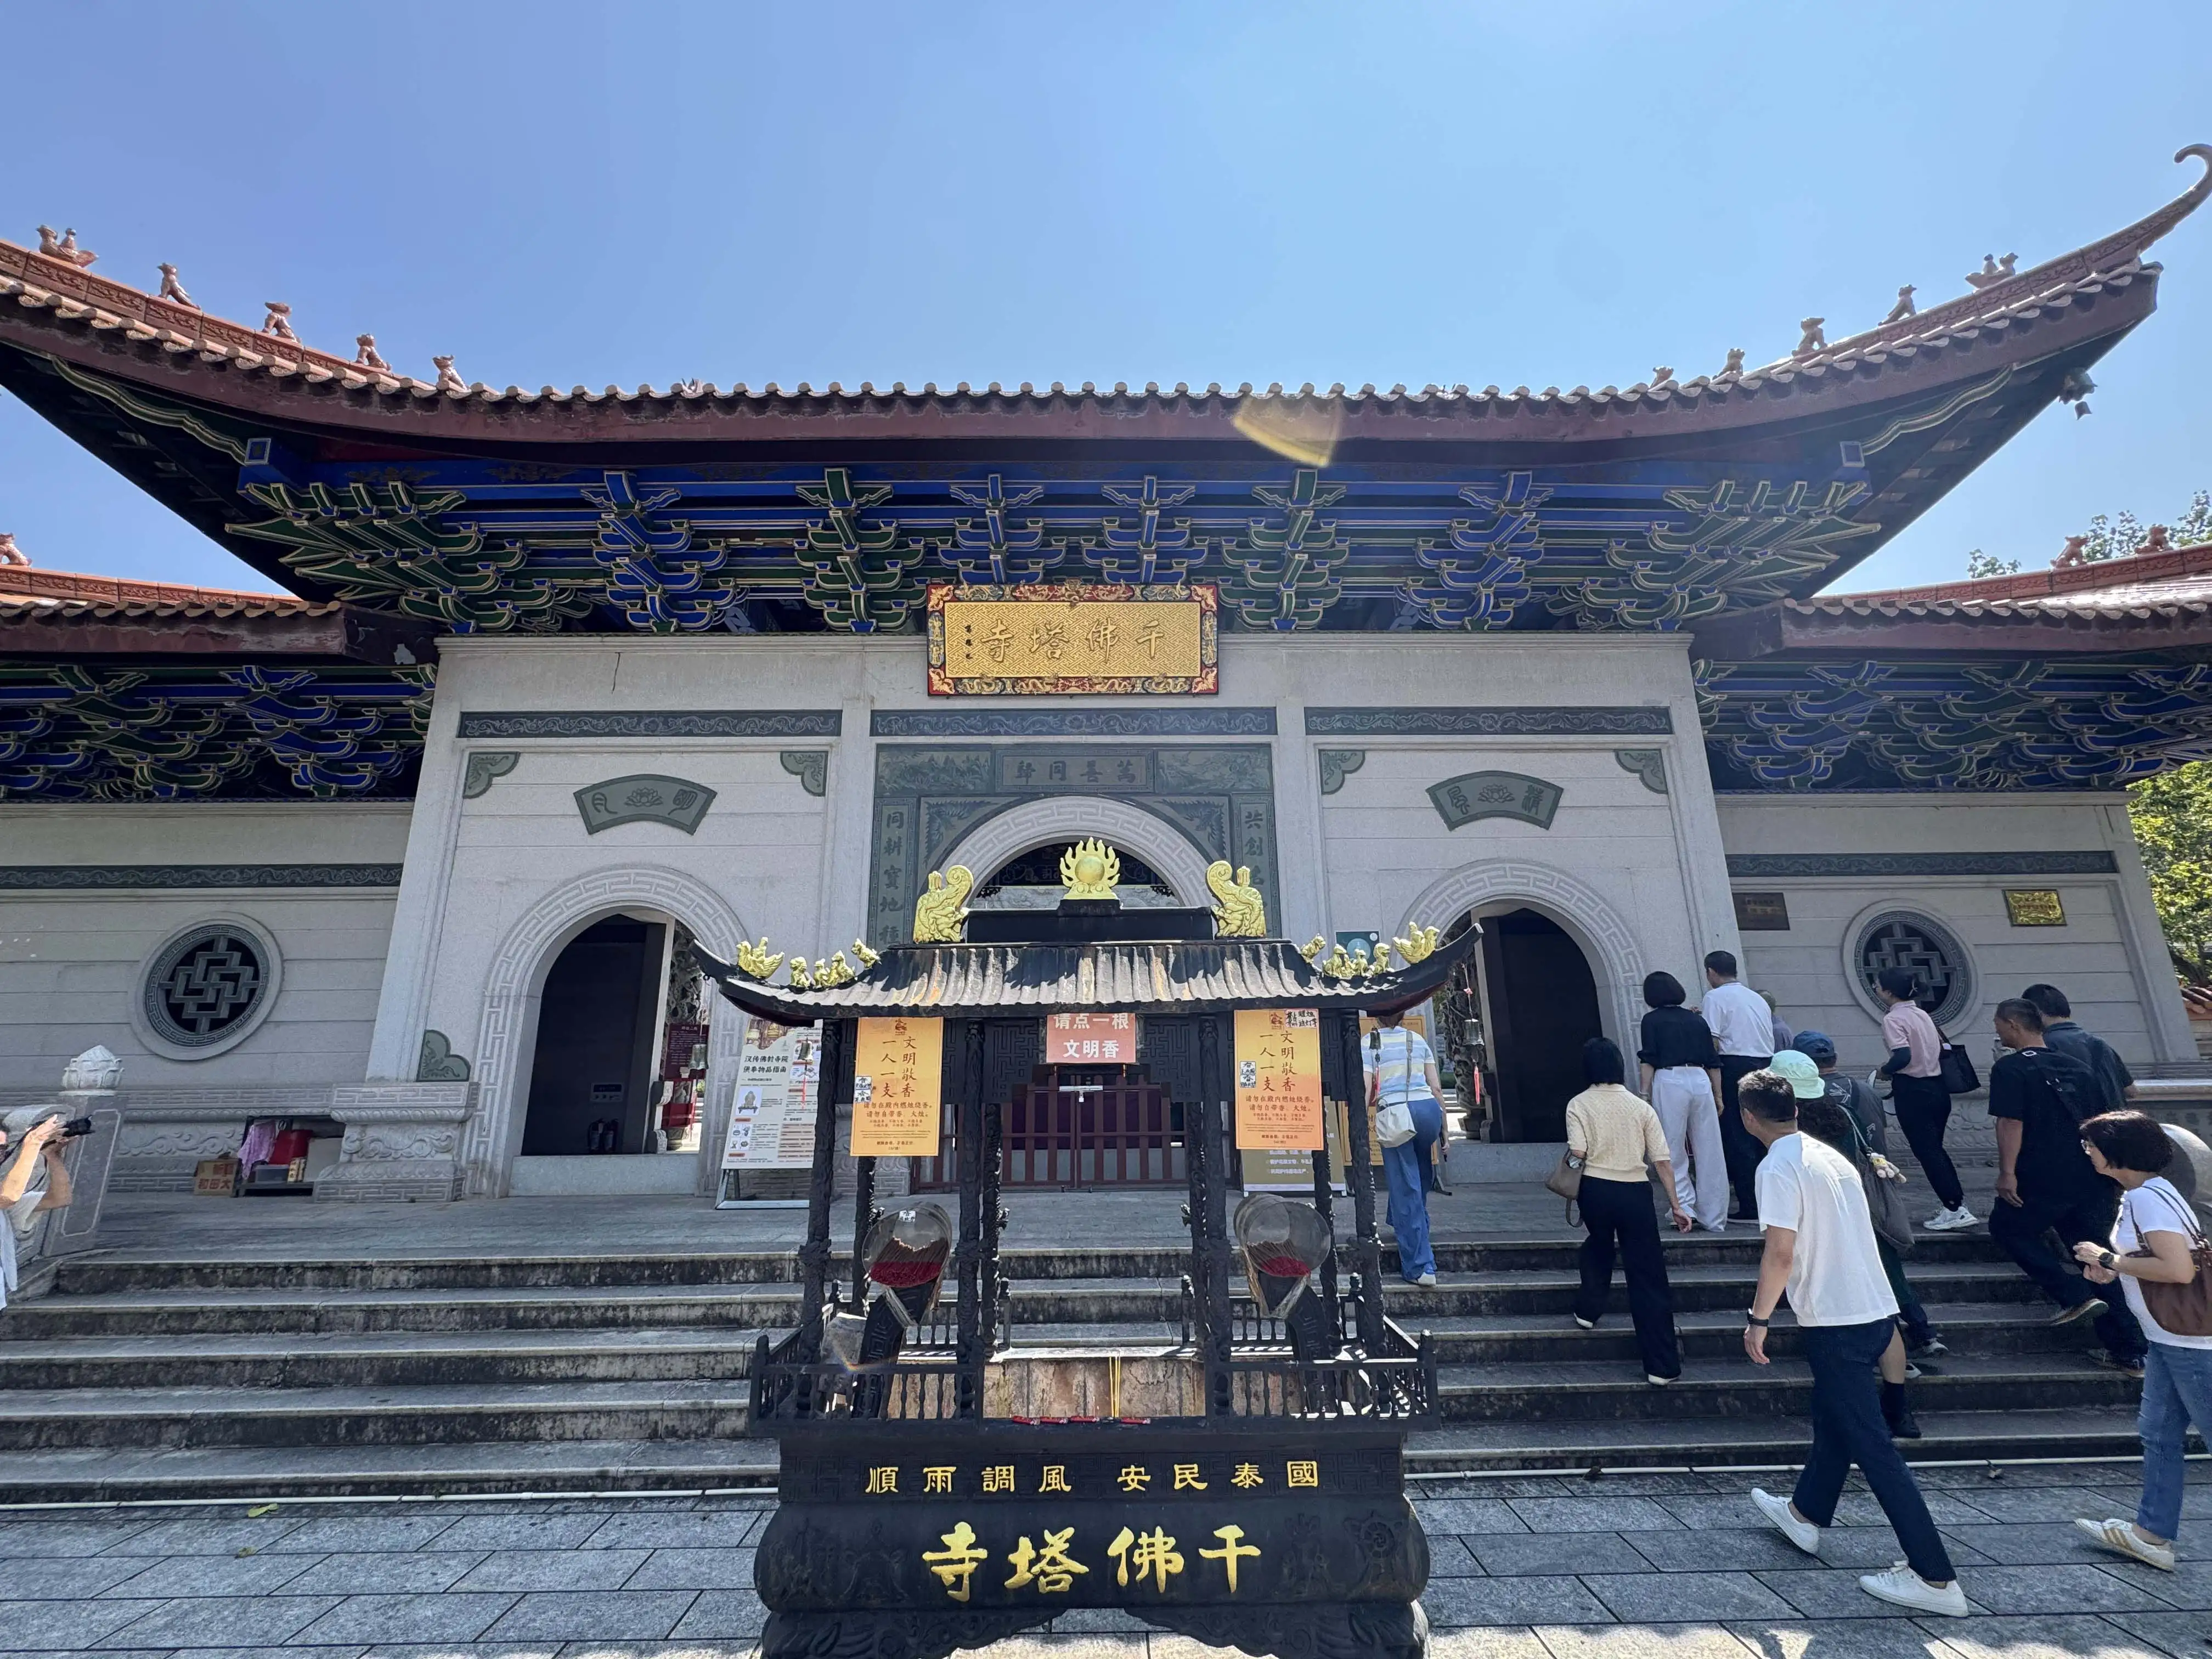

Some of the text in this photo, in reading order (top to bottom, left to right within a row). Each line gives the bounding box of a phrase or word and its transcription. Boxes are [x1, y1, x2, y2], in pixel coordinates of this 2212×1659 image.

[980, 618, 1165, 664] 千佛塔寺
[1053, 1013, 1129, 1030] 请点一根
[1063, 1039, 1119, 1058] 文明香
[880, 1040, 896, 1098] 一人一支
[900, 1036, 917, 1098] 文明敬香
[1259, 1034, 1276, 1092] 一人一支
[1280, 1030, 1297, 1092] 文明敬香
[865, 1460, 1319, 1494] 國泰民安 風調雨順
[922, 1521, 1261, 1602] 千佛塔寺
